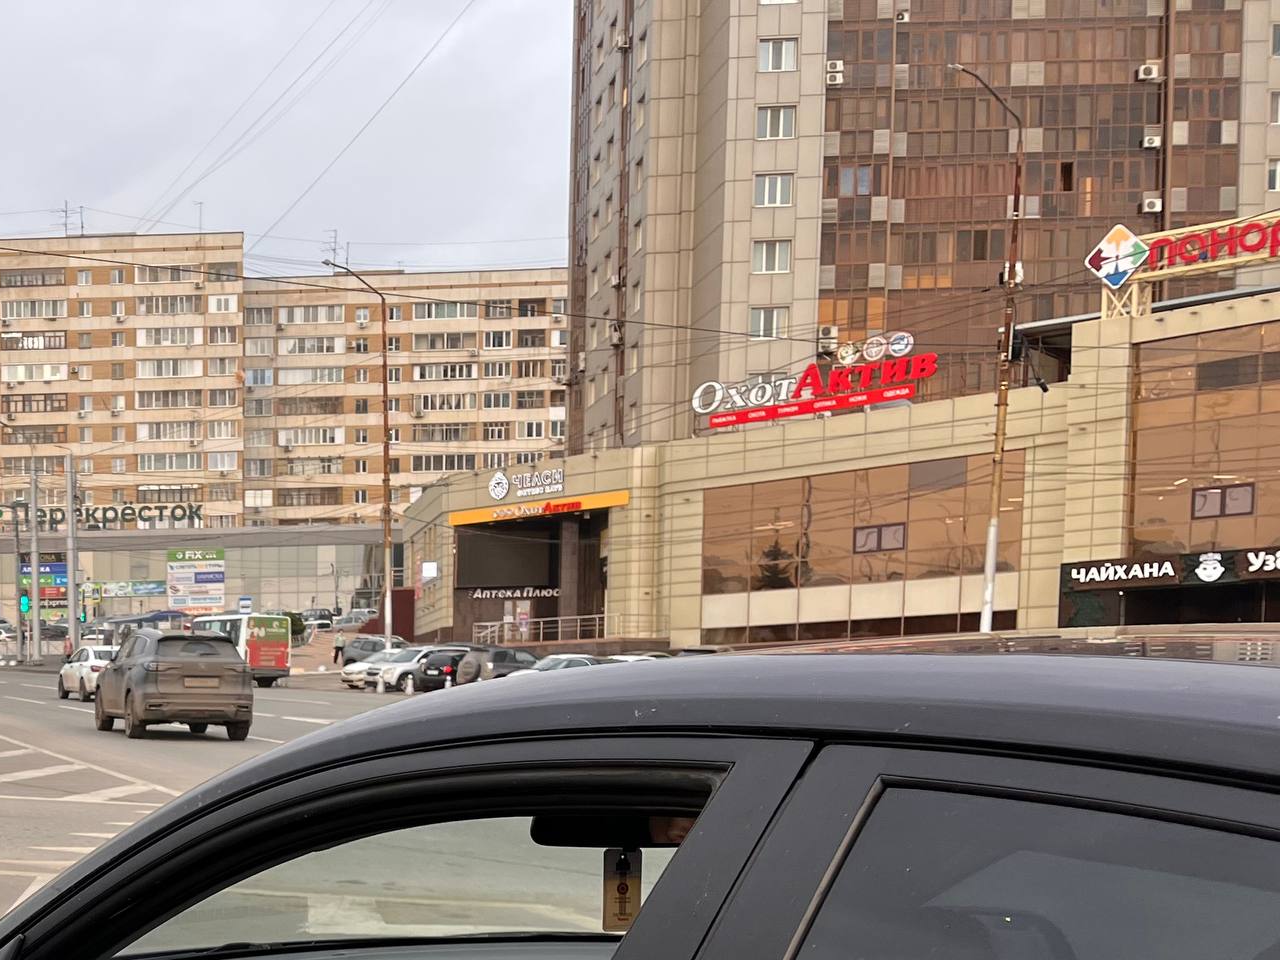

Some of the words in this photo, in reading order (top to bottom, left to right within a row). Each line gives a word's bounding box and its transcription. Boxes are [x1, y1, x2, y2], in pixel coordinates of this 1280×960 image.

[747, 410, 766, 419] ОХОТА
[777, 405, 799, 414] ТУРИЗМ
[813, 399, 837, 409] ОПТИКА
[882, 387, 910, 398] ОДЕЖДА
[511, 468, 564, 489] ЧЕЛСИ
[1070, 562, 1176, 583] ЧАЙХАНА
